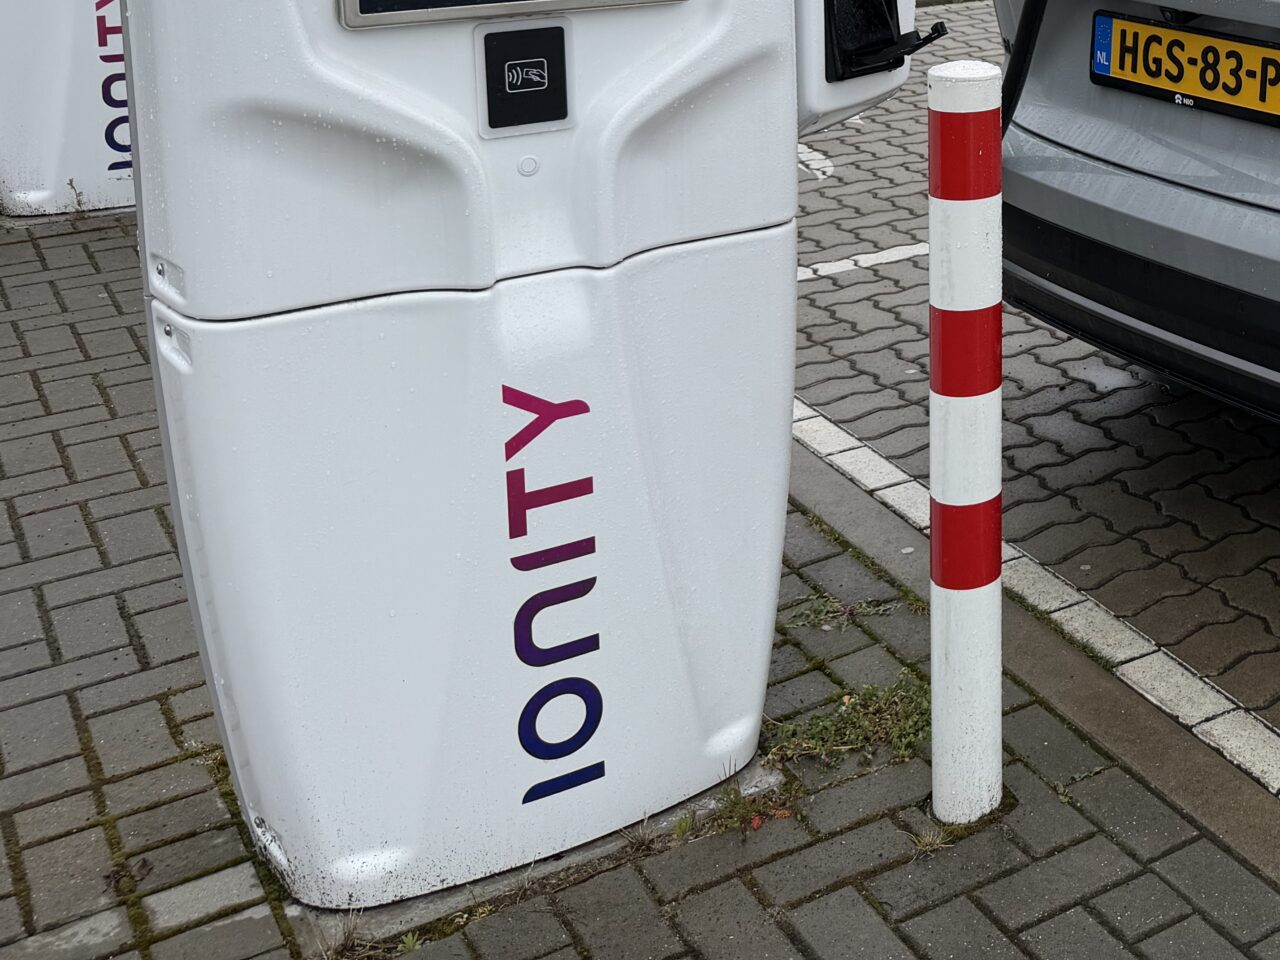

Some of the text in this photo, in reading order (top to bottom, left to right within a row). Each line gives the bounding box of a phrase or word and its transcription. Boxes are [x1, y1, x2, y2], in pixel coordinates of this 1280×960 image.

[1096, 50, 1109, 66] NL
[1183, 97, 1194, 106] NIO
[501, 384, 606, 805] IONITY
